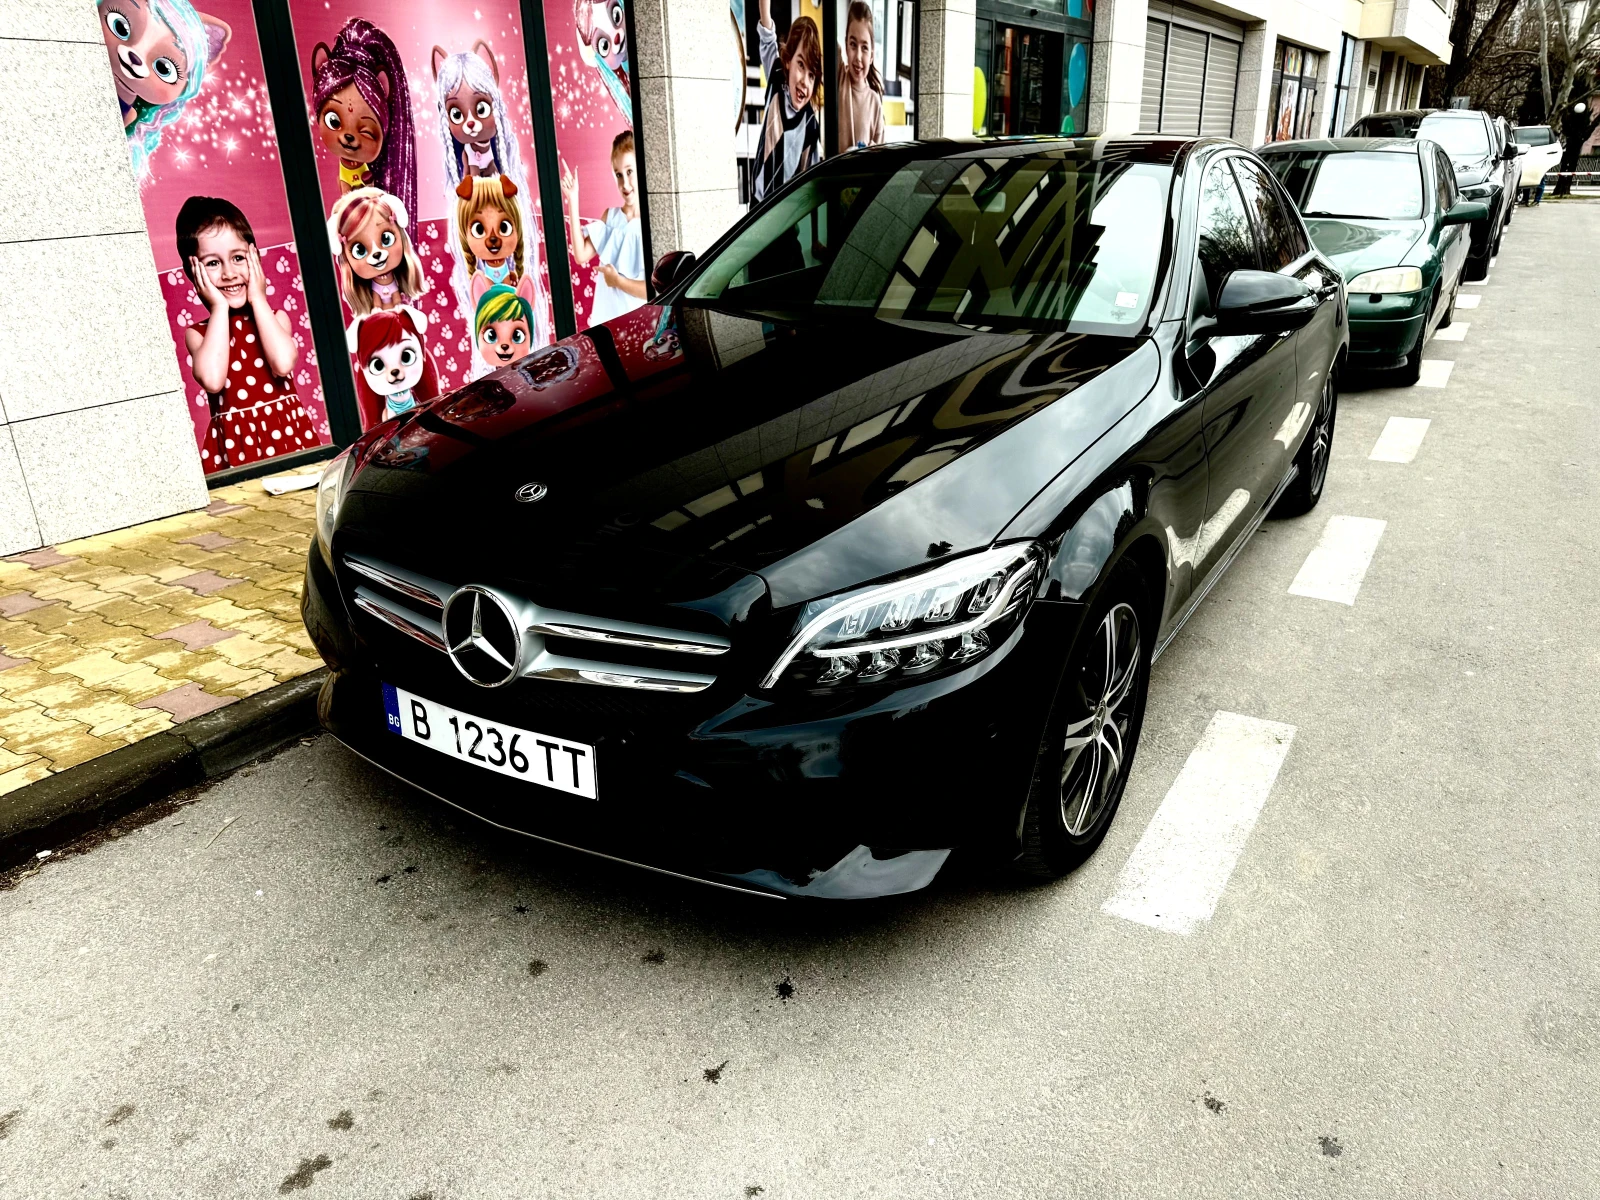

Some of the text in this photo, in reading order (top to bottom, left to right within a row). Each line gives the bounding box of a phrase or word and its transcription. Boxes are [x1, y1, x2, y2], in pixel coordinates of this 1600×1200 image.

[388, 713, 400, 728] BG
[410, 699, 586, 789] B 1236 TT
